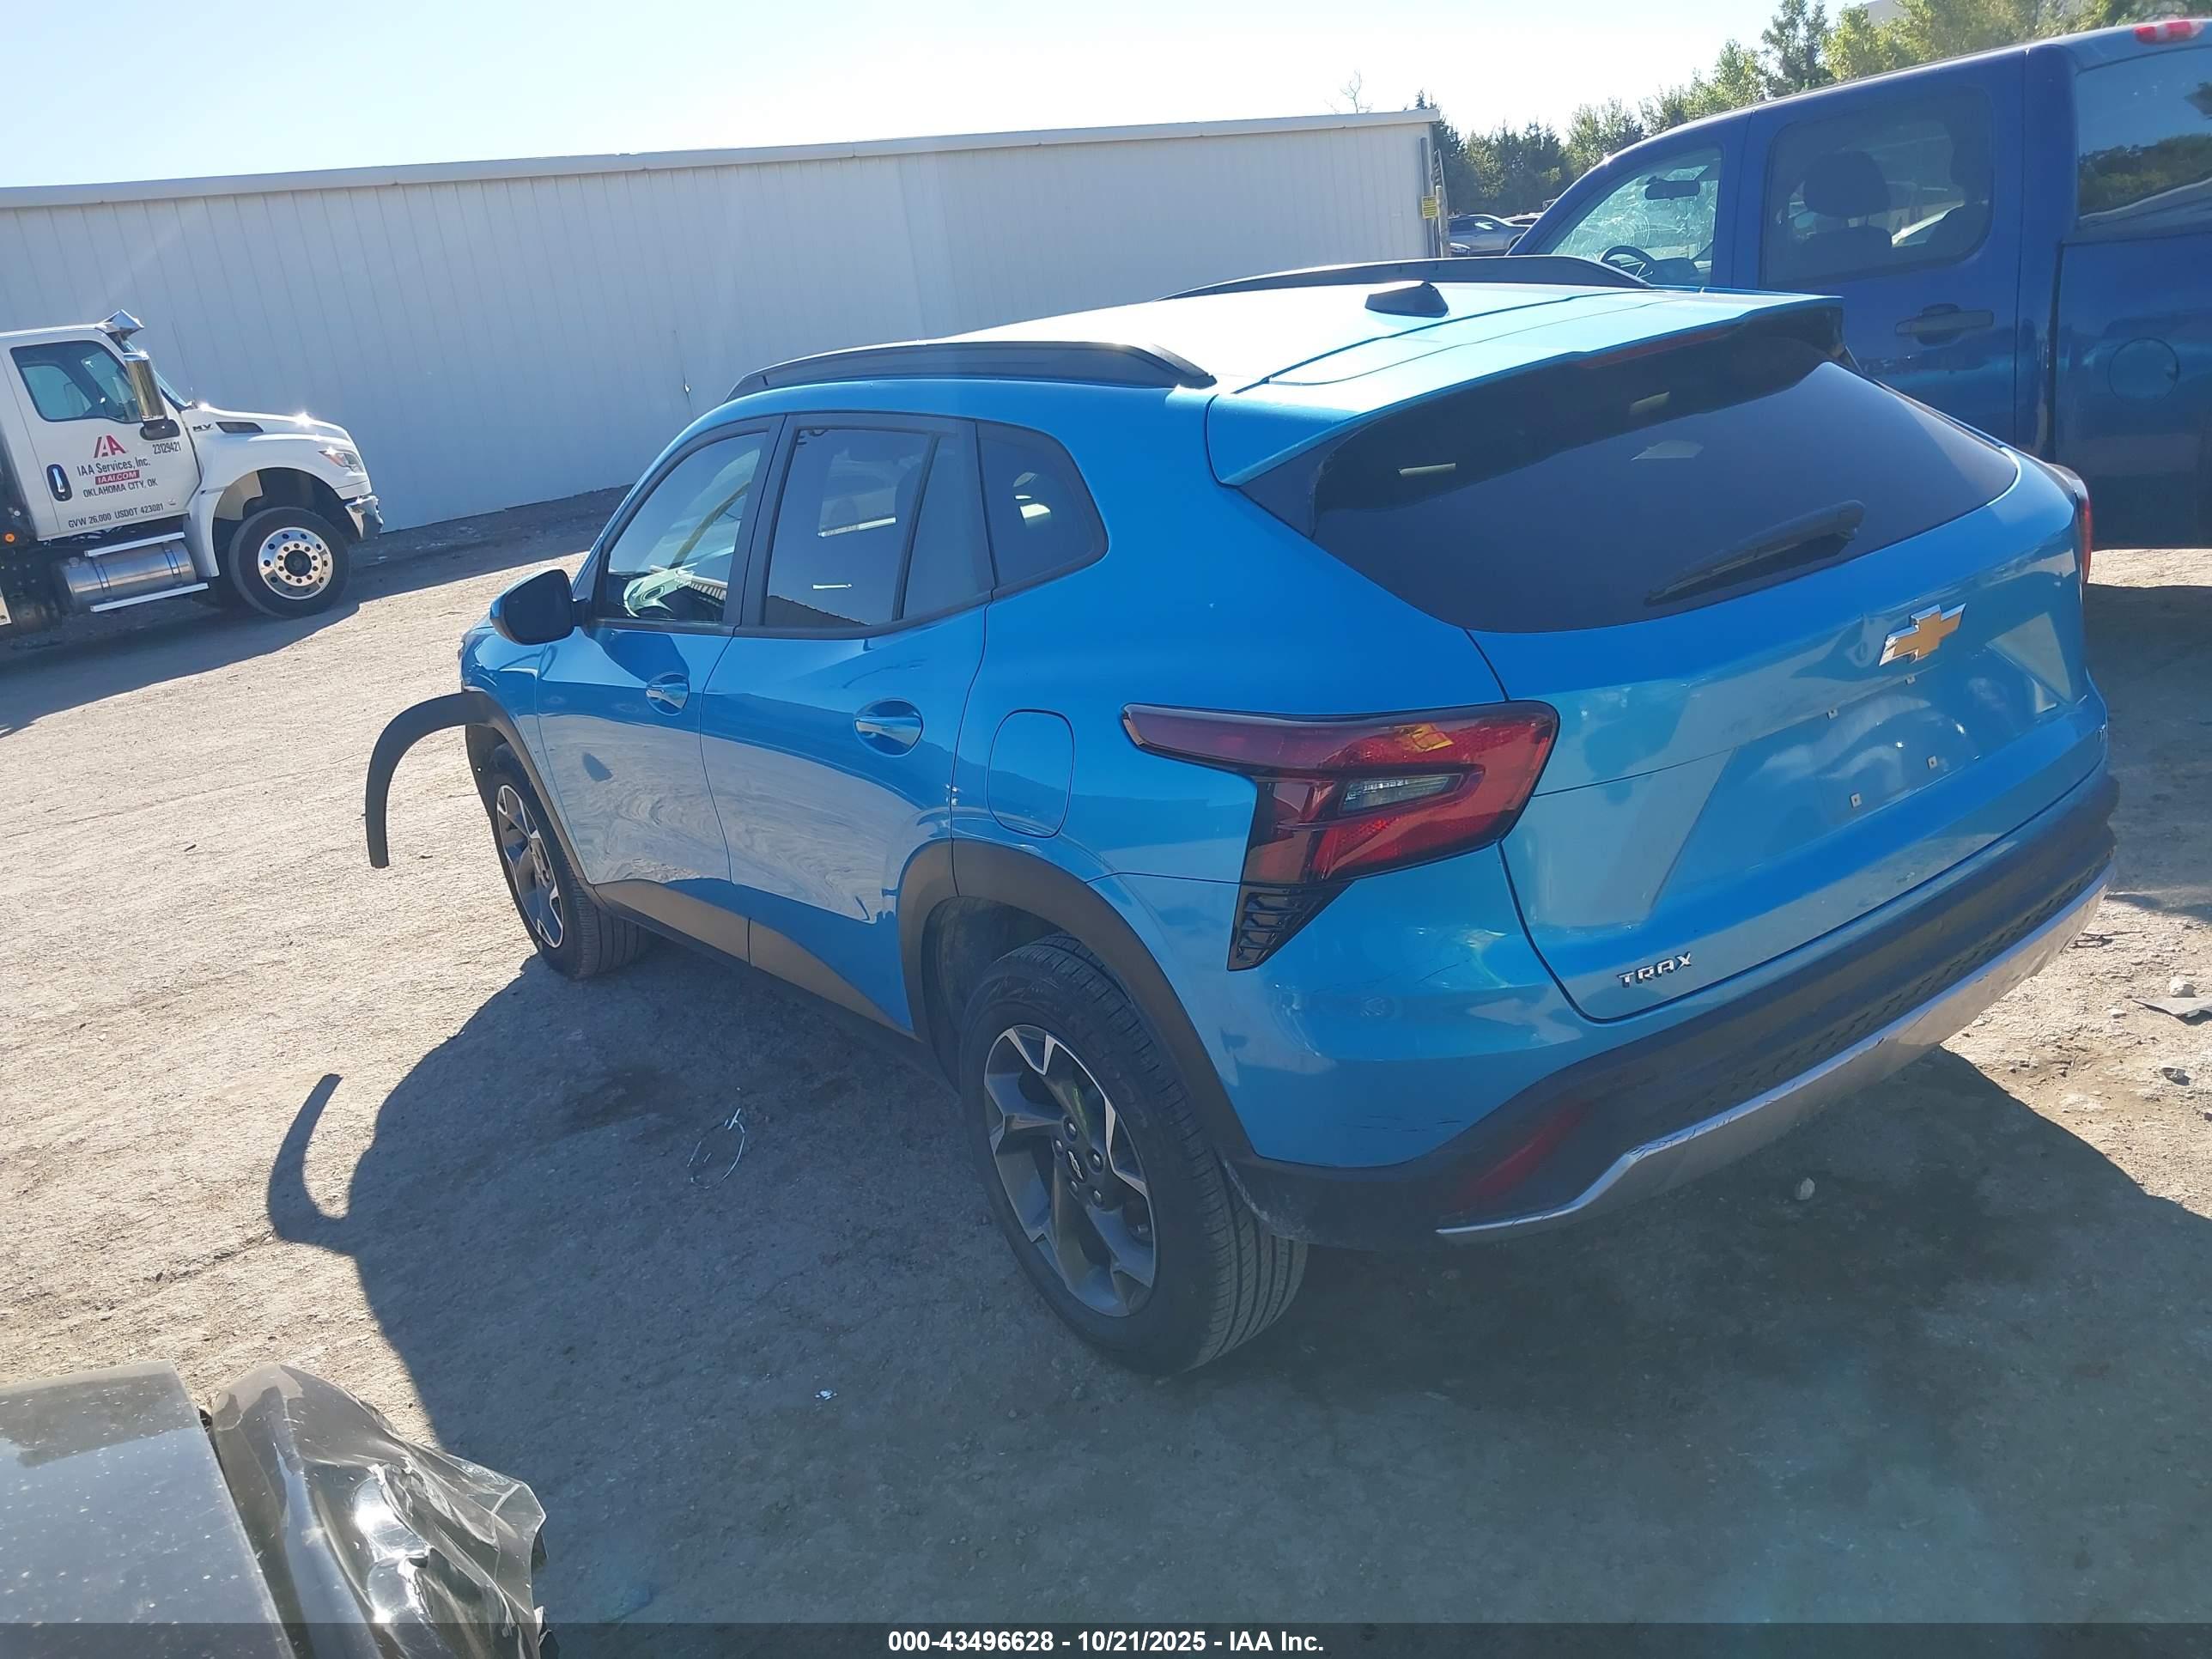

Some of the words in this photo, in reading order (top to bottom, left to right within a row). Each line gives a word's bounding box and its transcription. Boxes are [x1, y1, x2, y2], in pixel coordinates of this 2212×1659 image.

[152, 441, 181, 455] 23129421
[76, 465, 94, 477] IAA
[97, 459, 136, 473] Services,
[135, 457, 150, 468] Inc.
[97, 471, 137, 483] IAAI.COM
[83, 485, 126, 498] OKLAHOMA
[147, 478, 158, 488] OK
[68, 517, 87, 528] GVW
[114, 507, 138, 519] USDOT
[140, 503, 164, 514] 423081
[1618, 951, 1692, 987] TRAX
